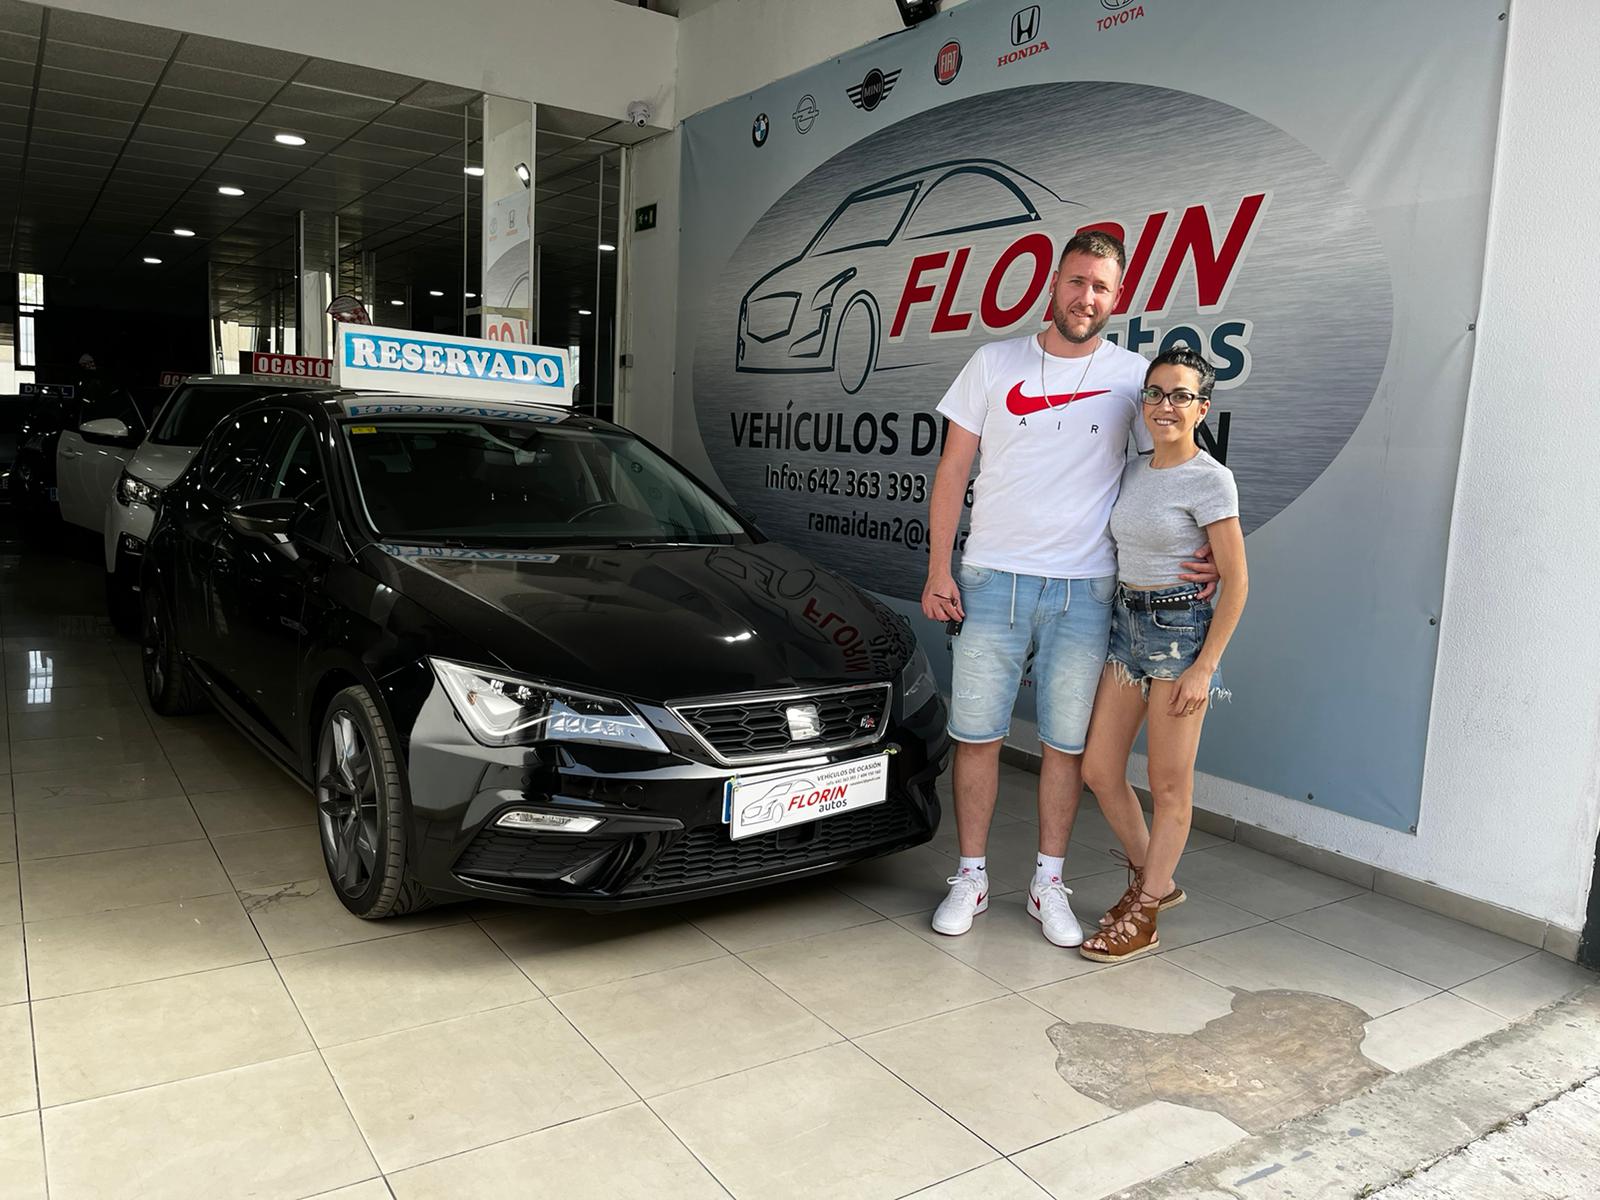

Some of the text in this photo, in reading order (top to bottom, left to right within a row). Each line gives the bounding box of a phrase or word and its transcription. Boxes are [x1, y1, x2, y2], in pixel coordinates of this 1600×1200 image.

[1096, 6, 1145, 32] TOYOTA
[940, 50, 958, 75] FIAT
[997, 41, 1050, 67] HONDA
[863, 82, 882, 97] MINI
[352, 337, 560, 384] RESERVADO
[730, 399, 899, 456] VEHÍCULOS
[765, 462, 804, 492] Info:
[807, 467, 840, 496] 642
[845, 469, 882, 499] 363
[886, 472, 928, 504] 393
[848, 767, 857, 775] DE
[787, 784, 848, 812] FLORIN
[818, 798, 848, 813] autos
